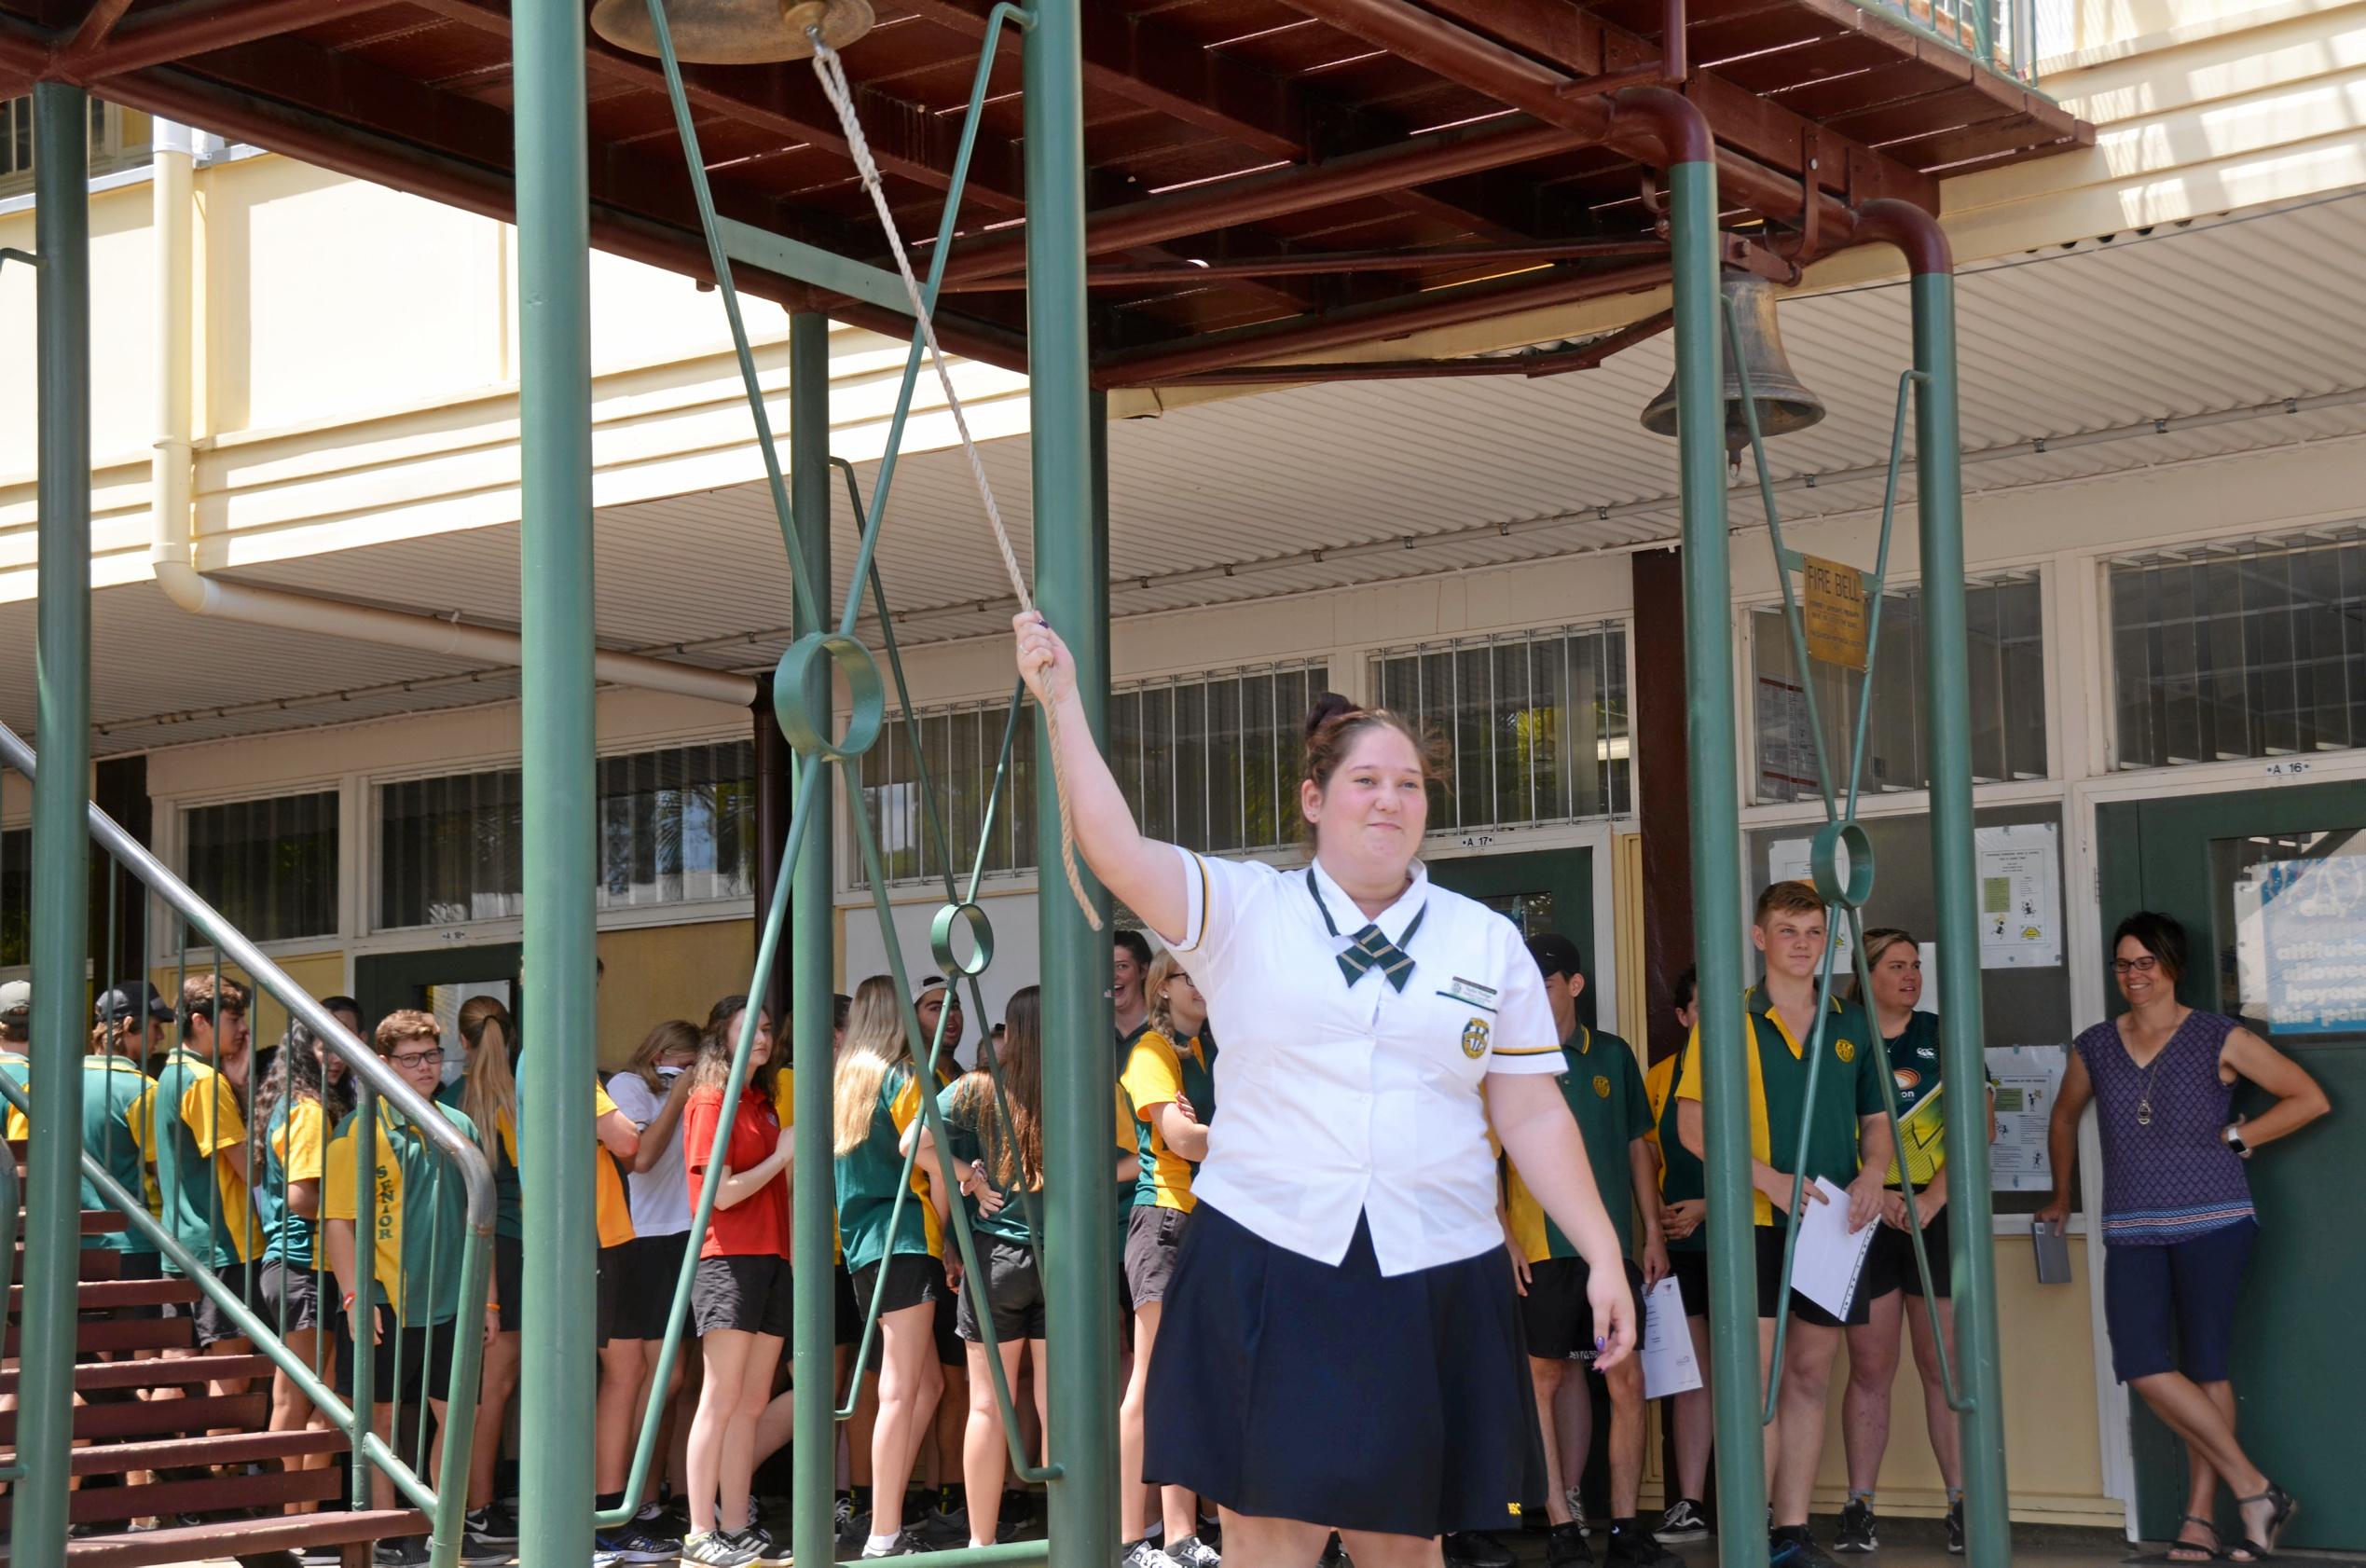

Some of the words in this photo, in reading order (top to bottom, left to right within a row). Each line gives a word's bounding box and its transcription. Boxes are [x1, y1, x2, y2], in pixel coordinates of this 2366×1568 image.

[1808, 565, 1831, 595] FIRE
[1835, 572, 1860, 602] BELL
[2273, 764, 2281, 774] A
[2289, 763, 2303, 773] 16
[1466, 837, 1474, 846] A
[1479, 836, 1489, 846] 17
[2272, 1005, 2315, 1024] this
[376, 1165, 393, 1239] SENIOR
